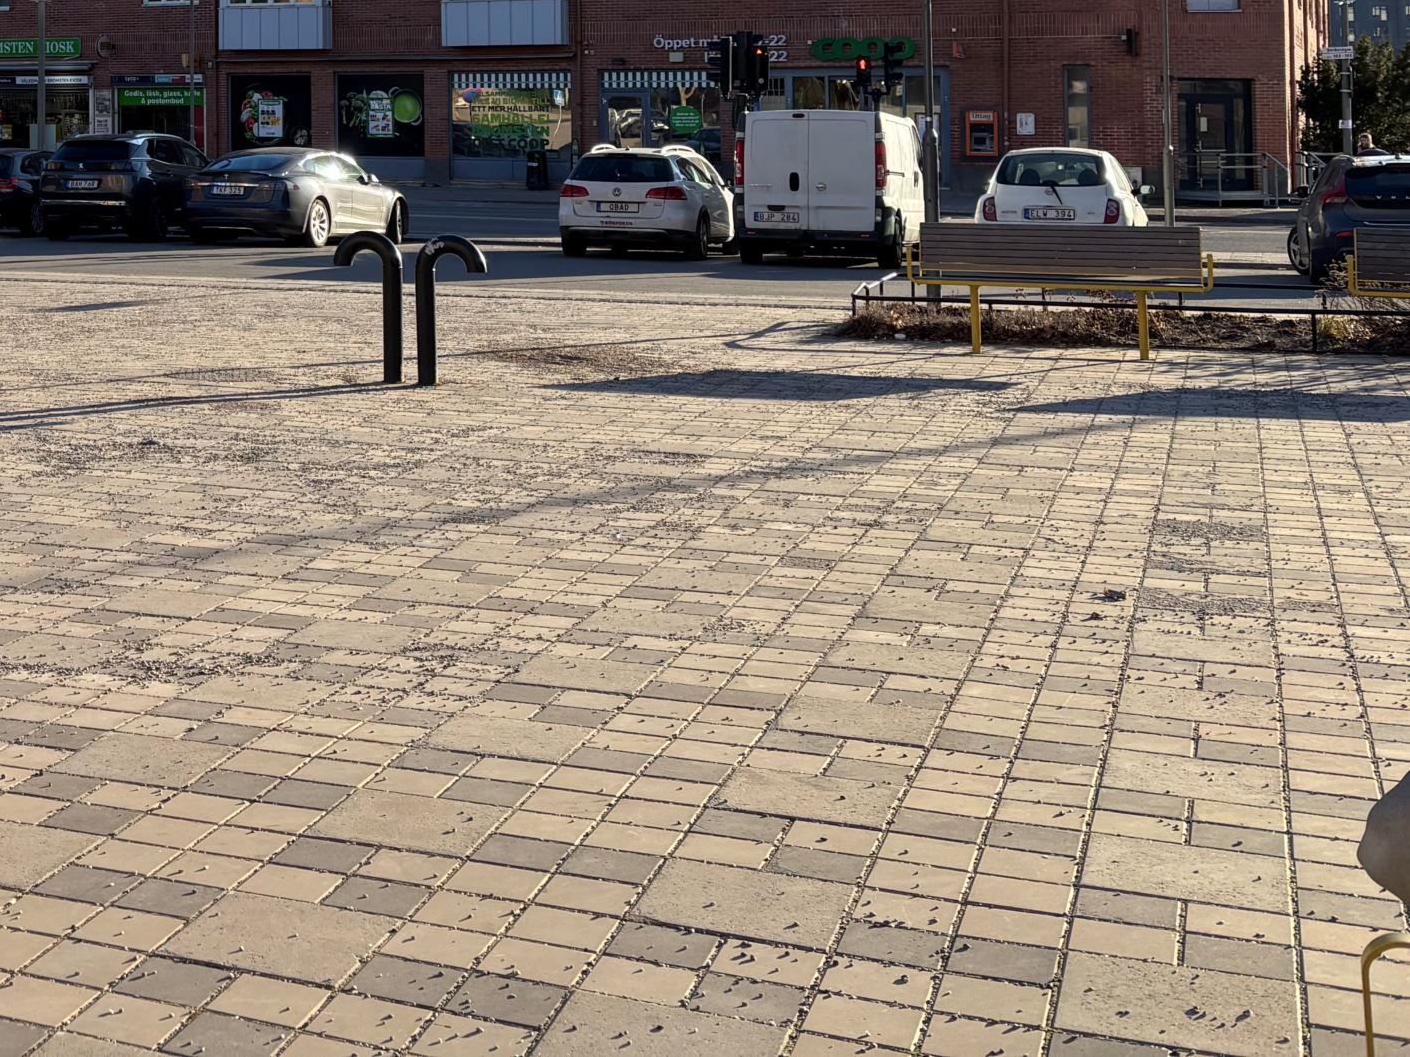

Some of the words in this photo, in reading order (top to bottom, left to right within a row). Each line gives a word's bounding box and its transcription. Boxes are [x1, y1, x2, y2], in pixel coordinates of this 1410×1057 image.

[37, 41, 75, 54] IOSK
[653, 34, 695, 50] Öppet
[163, 90, 183, 98] glass,
